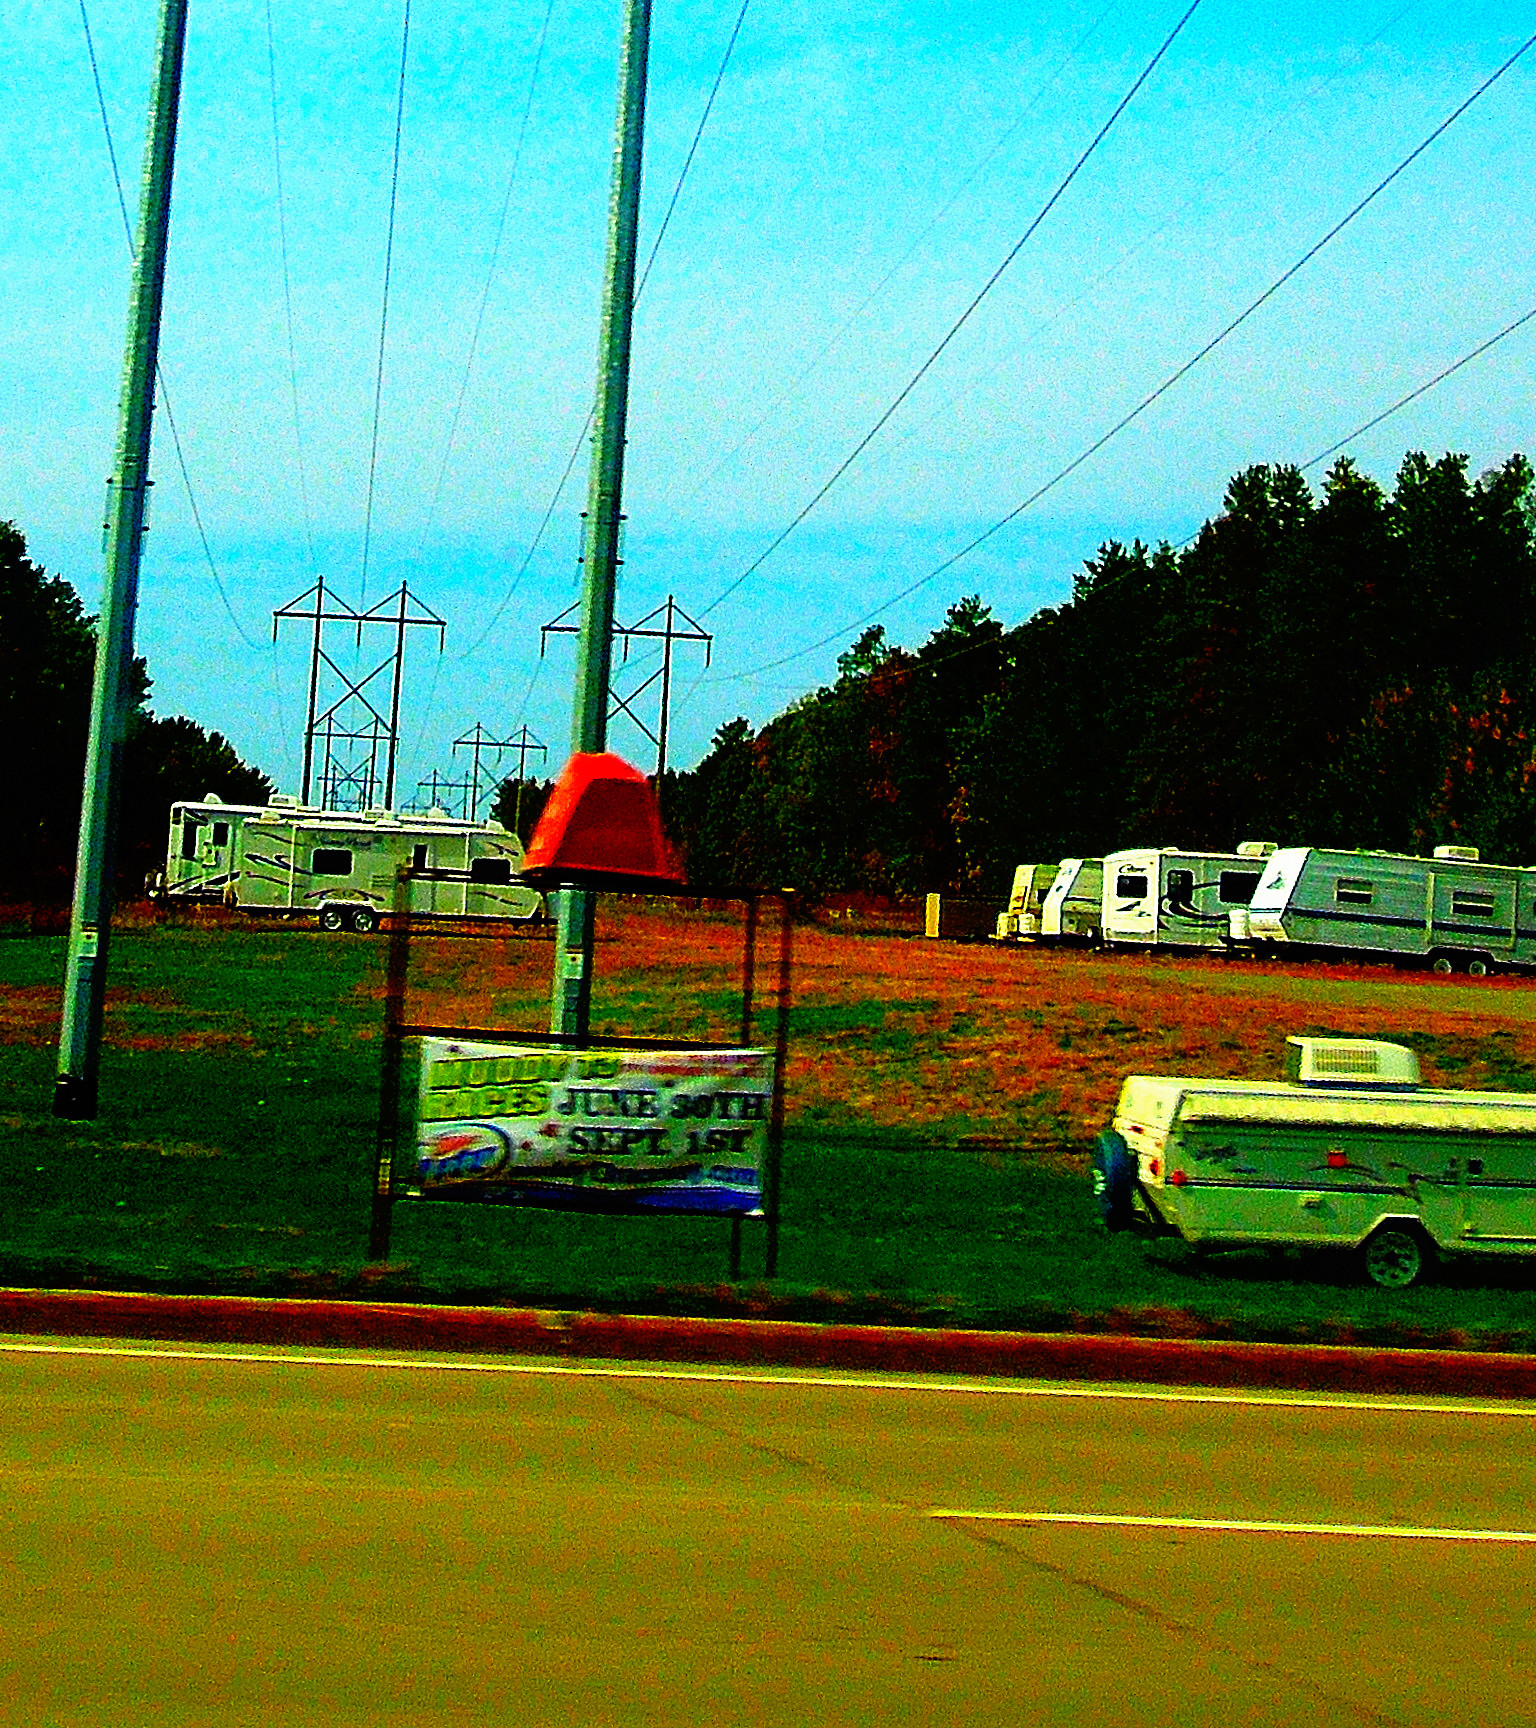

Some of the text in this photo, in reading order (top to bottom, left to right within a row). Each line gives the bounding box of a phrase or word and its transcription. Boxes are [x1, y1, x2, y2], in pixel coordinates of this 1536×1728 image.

[557, 1088, 765, 1119] JUNE 30TH
[687, 1129, 753, 1155] 1ST
